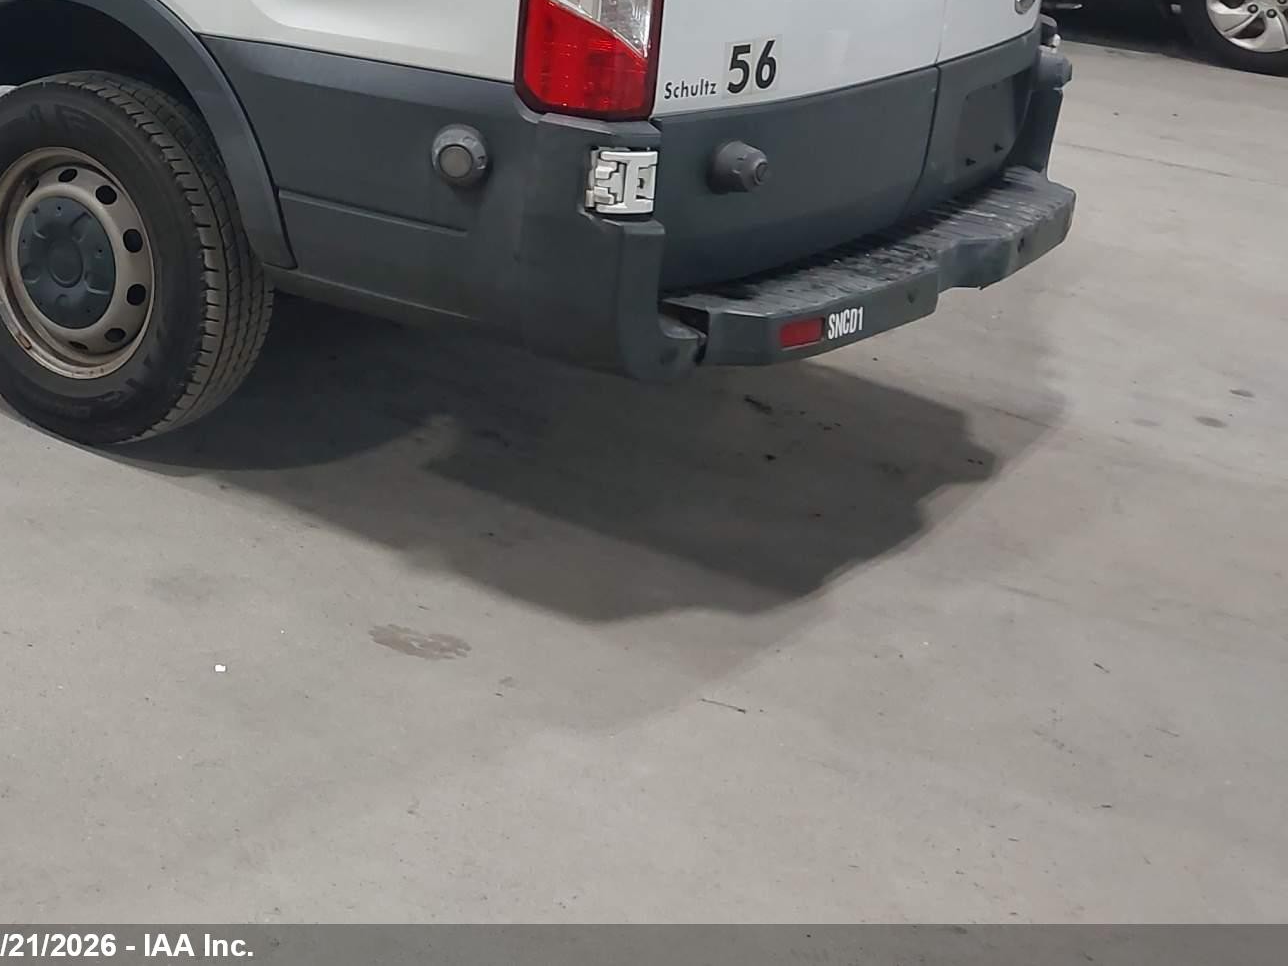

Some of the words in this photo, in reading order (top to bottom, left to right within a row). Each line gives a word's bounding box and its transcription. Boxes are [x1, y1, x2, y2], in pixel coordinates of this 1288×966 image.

[664, 79, 717, 100] Schultz
[727, 39, 777, 94] 56
[827, 306, 864, 340] SNCD1
